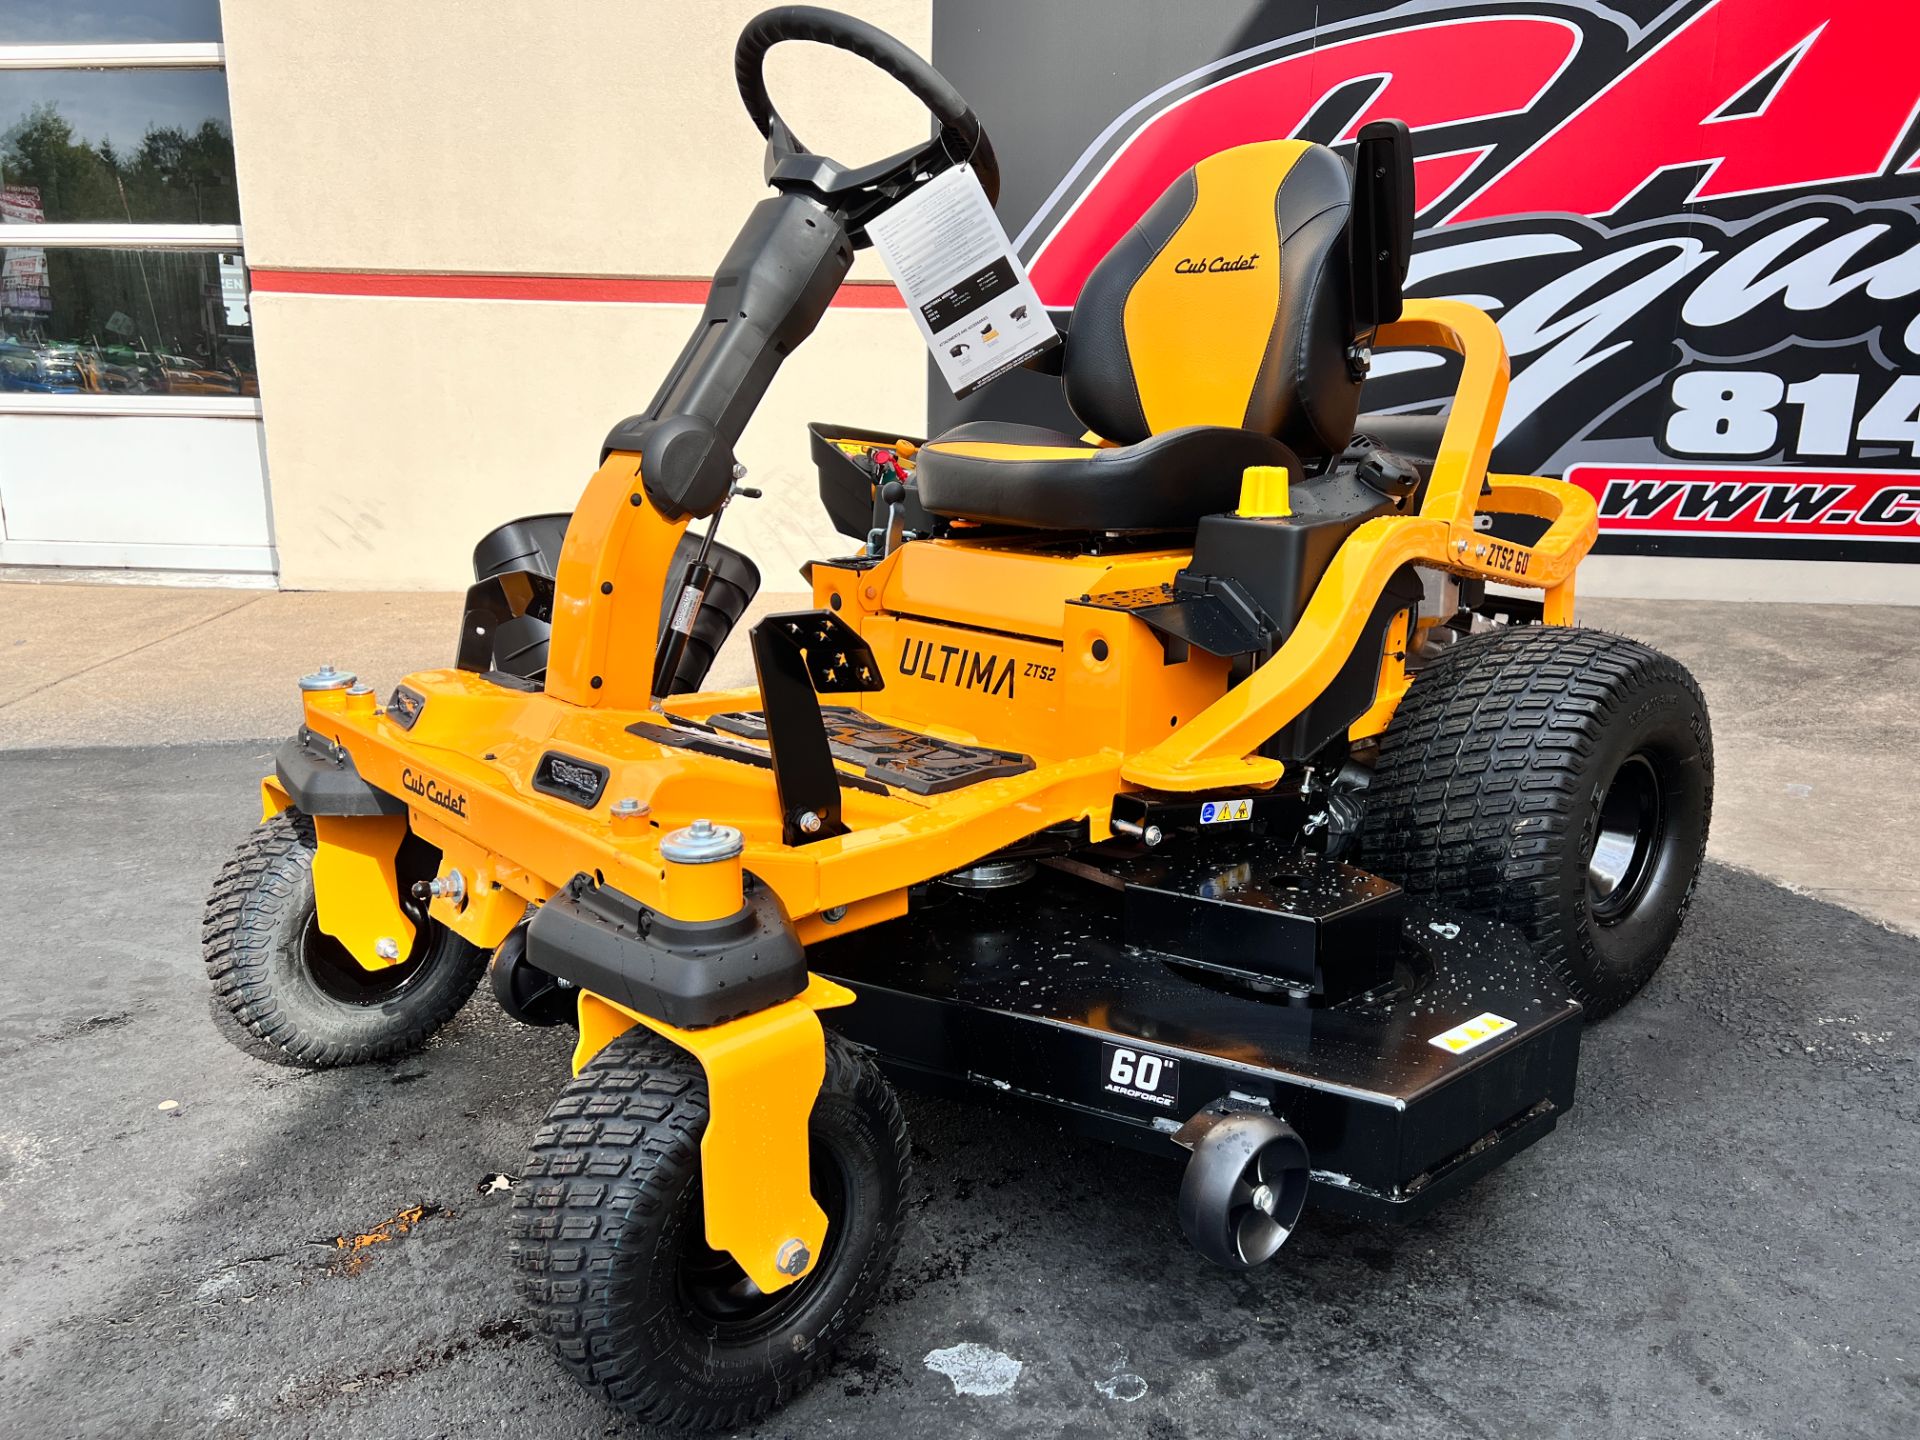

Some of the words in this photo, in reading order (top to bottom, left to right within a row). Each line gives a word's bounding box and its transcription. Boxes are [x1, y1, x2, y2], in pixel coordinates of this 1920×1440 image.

[1174, 257, 1207, 274] Cub
[1207, 252, 1260, 273] Cadet
[1665, 370, 1920, 458] 814
[1486, 543, 1514, 572] ZTS2
[899, 637, 1015, 700] ULTIMA
[1023, 662, 1057, 682] ZTS2
[402, 767, 425, 797] Cub
[426, 780, 467, 819] Cadet
[1109, 1048, 1174, 1092] 60"
[1104, 1083, 1174, 1107] AEROFORCE
